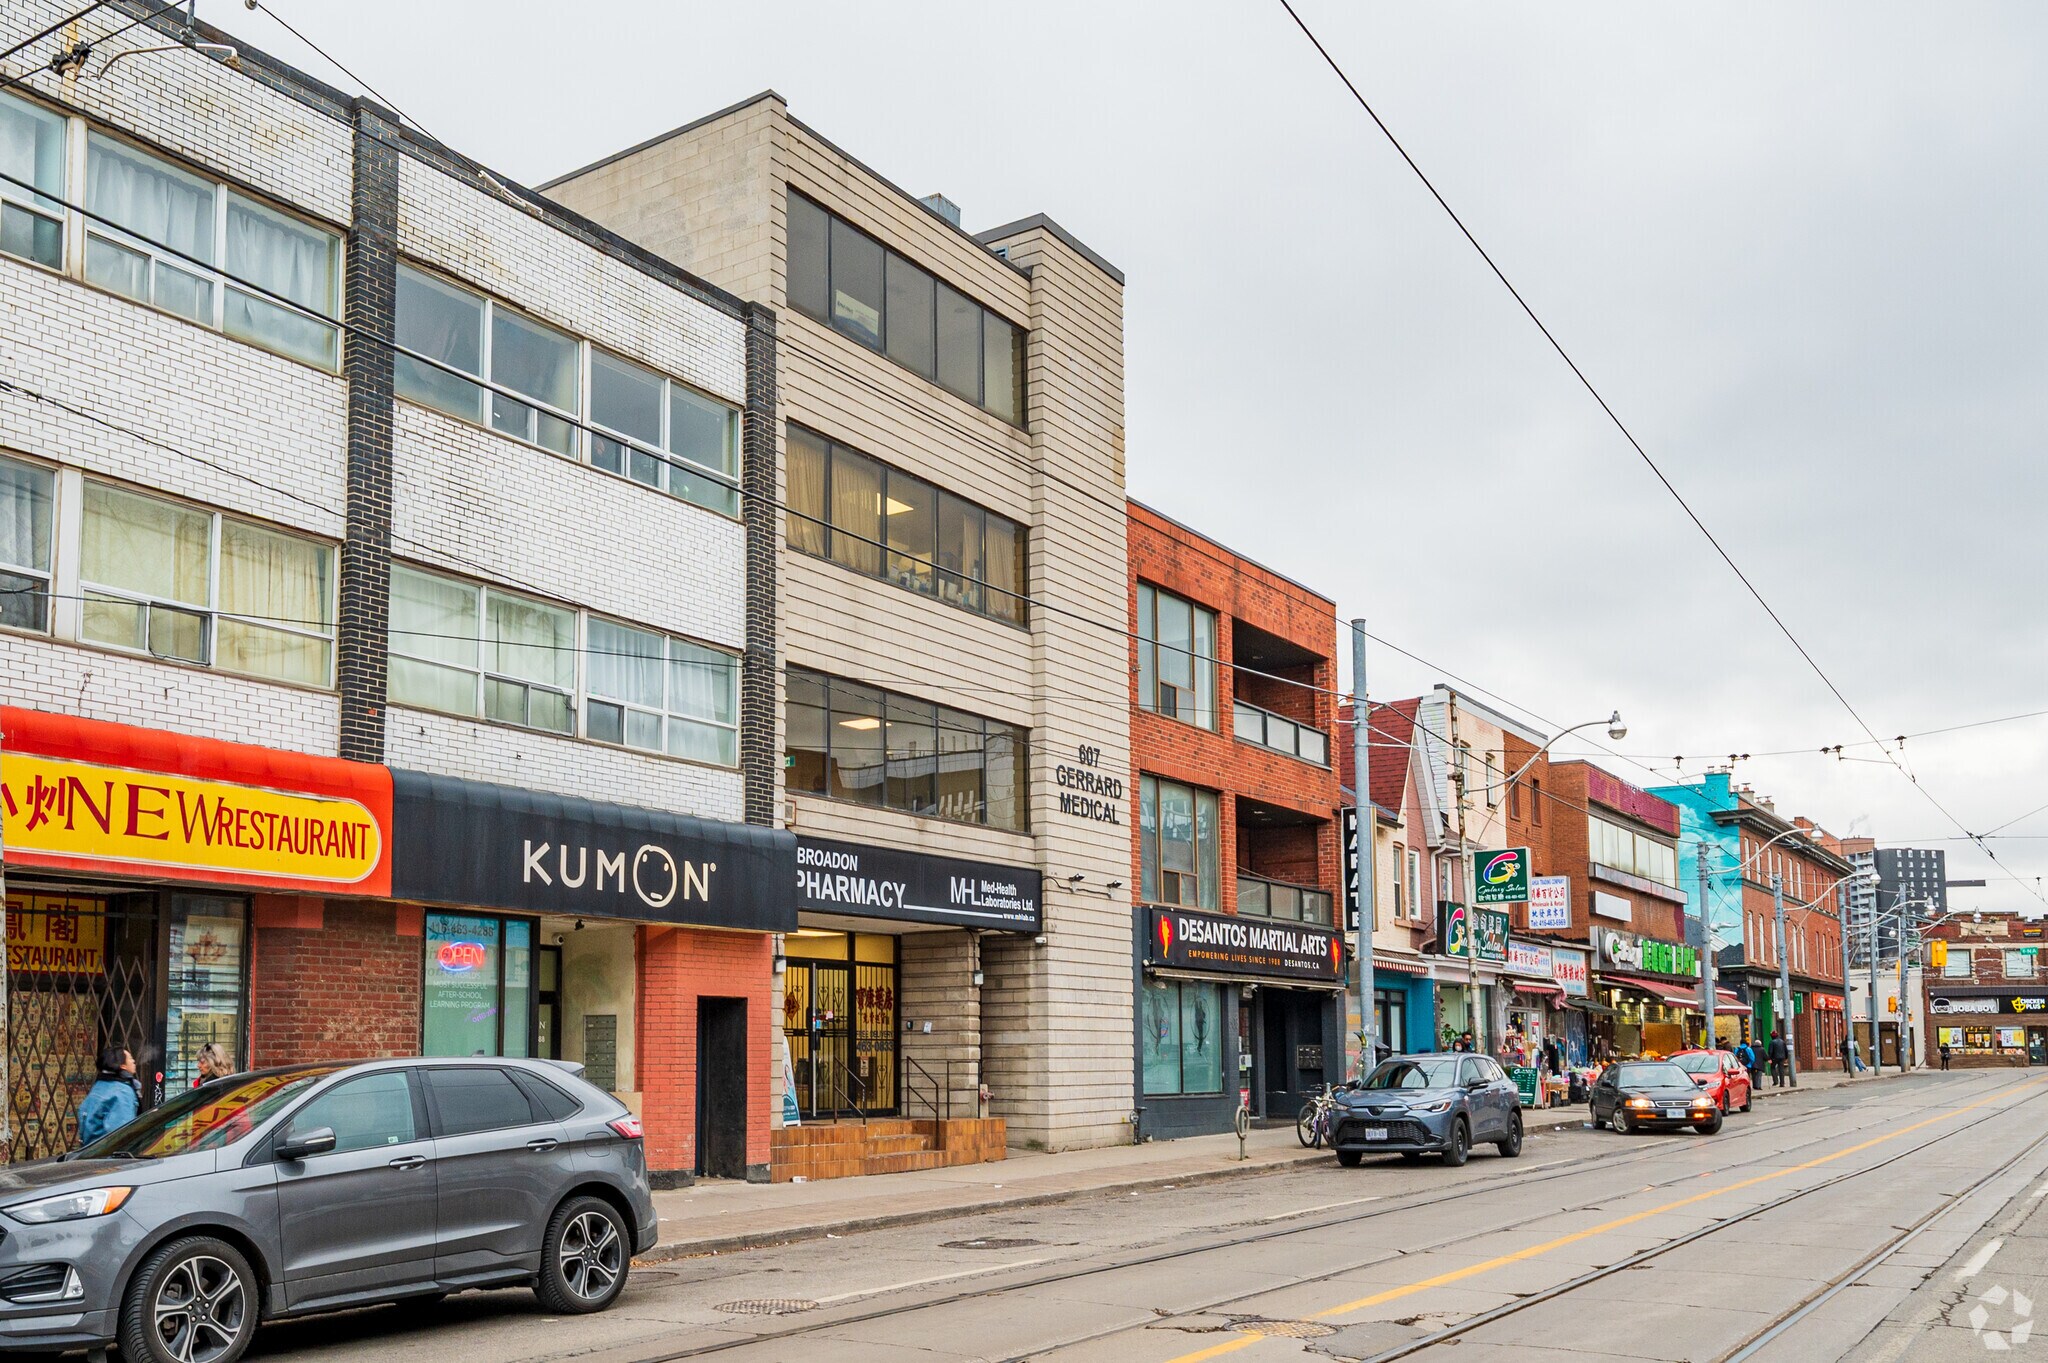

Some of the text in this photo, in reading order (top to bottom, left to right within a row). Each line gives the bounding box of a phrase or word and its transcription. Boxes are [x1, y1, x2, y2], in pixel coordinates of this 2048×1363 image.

[1079, 744, 1100, 768] 607
[1056, 765, 1122, 799] GERRARD
[64, 776, 371, 861] NEW RESTAURANT
[1060, 792, 1120, 825] MEDICAL
[797, 847, 858, 871] BROADON
[797, 870, 906, 908] PHARMACY
[981, 880, 1017, 896] Med-Health
[1505, 884, 1526, 893] Salon
[981, 895, 1035, 912] Laboratories Ltd.
[1179, 917, 1328, 957] DESANTOS MARTIAL ARTS
[441, 946, 483, 966] OPEN
[1188, 949, 1229, 962] EMPOWERING
[1231, 953, 1247, 963] LIVES
[1249, 955, 1266, 965] SINCE
[1284, 959, 1320, 970] DESANTOS.CA
[429, 1000, 491, 1010] LEARNING PROGRAM
[437, 990, 483, 1000] AFTER-SCHOOL
[1952, 1004, 1995, 1013] BOBA BOY
